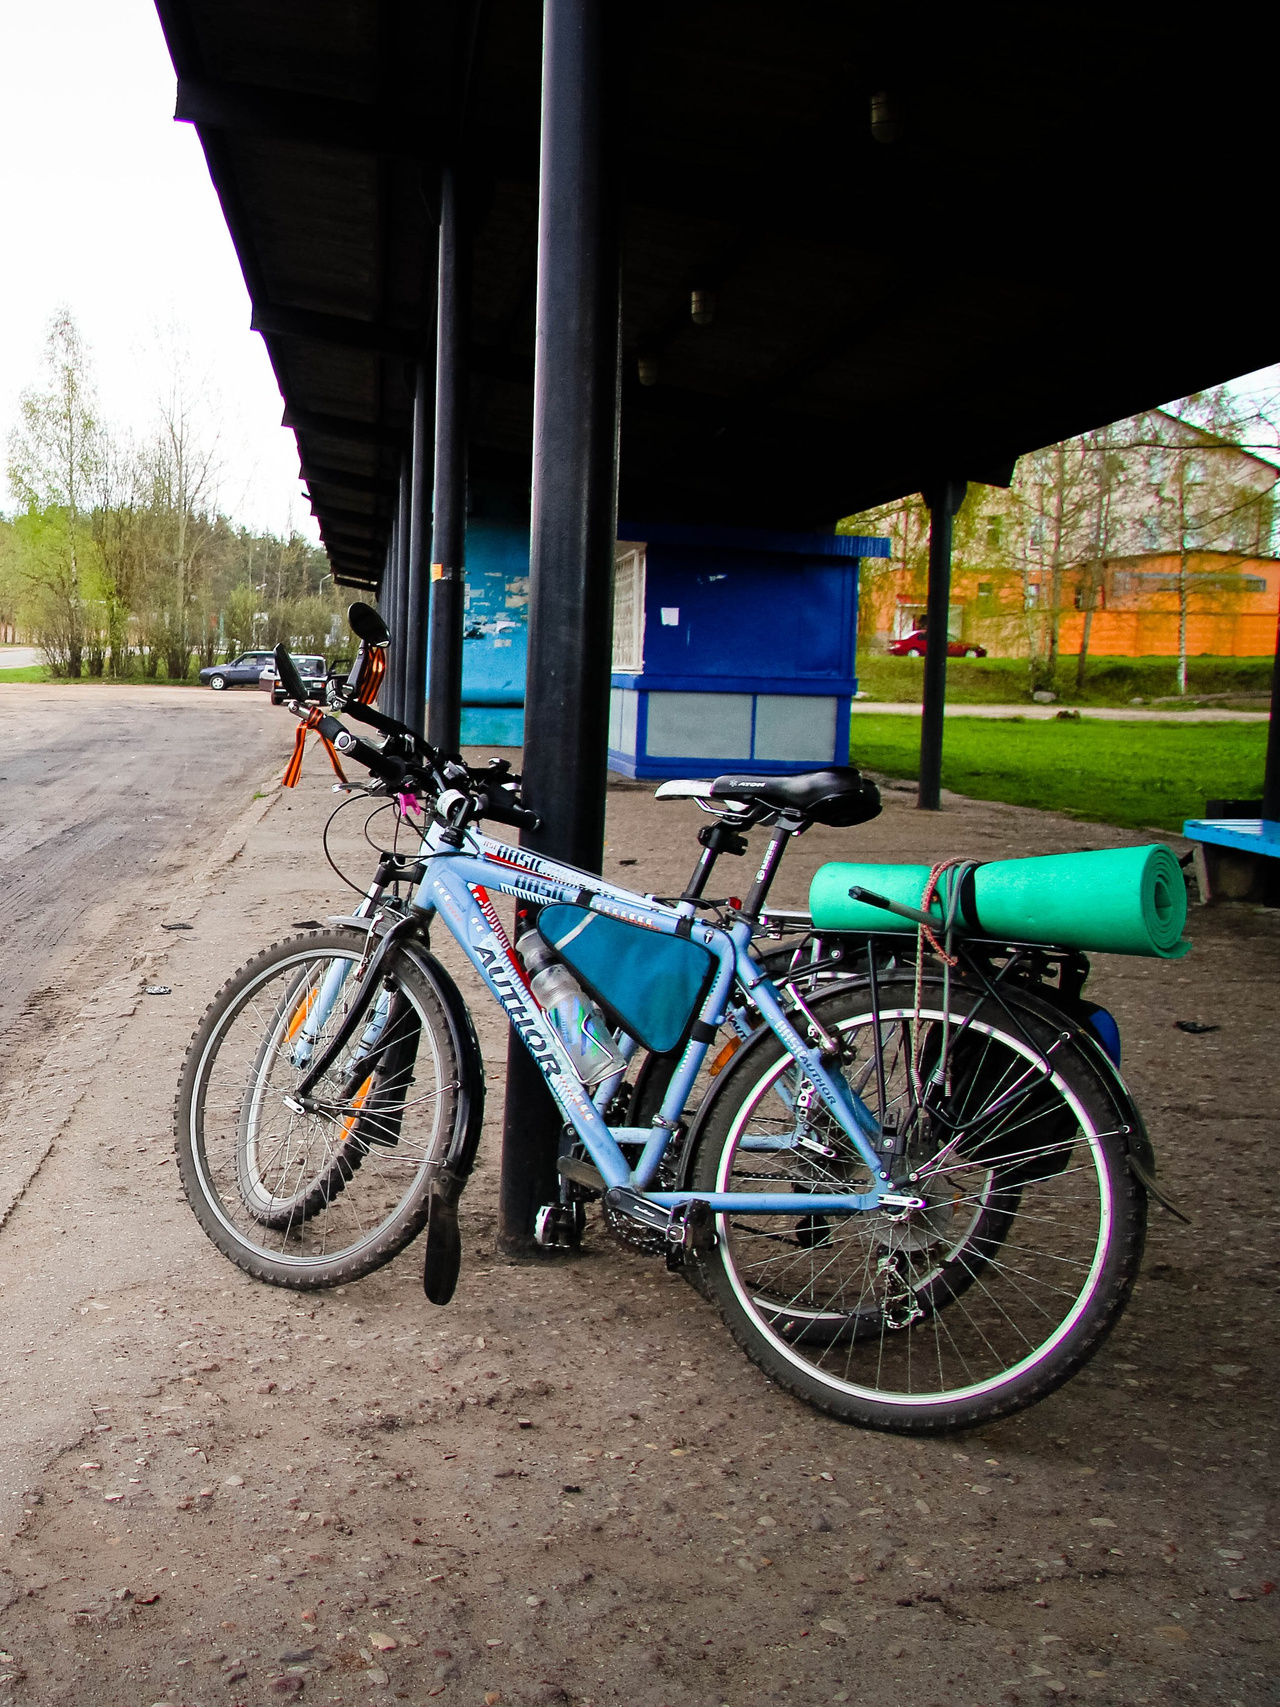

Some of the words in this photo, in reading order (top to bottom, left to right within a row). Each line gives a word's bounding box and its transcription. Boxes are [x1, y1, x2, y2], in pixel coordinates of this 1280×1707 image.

[473, 945, 561, 1079] AUTHOR
[730, 1020, 748, 1039] AUT
[800, 1056, 837, 1105] AUTHOR
